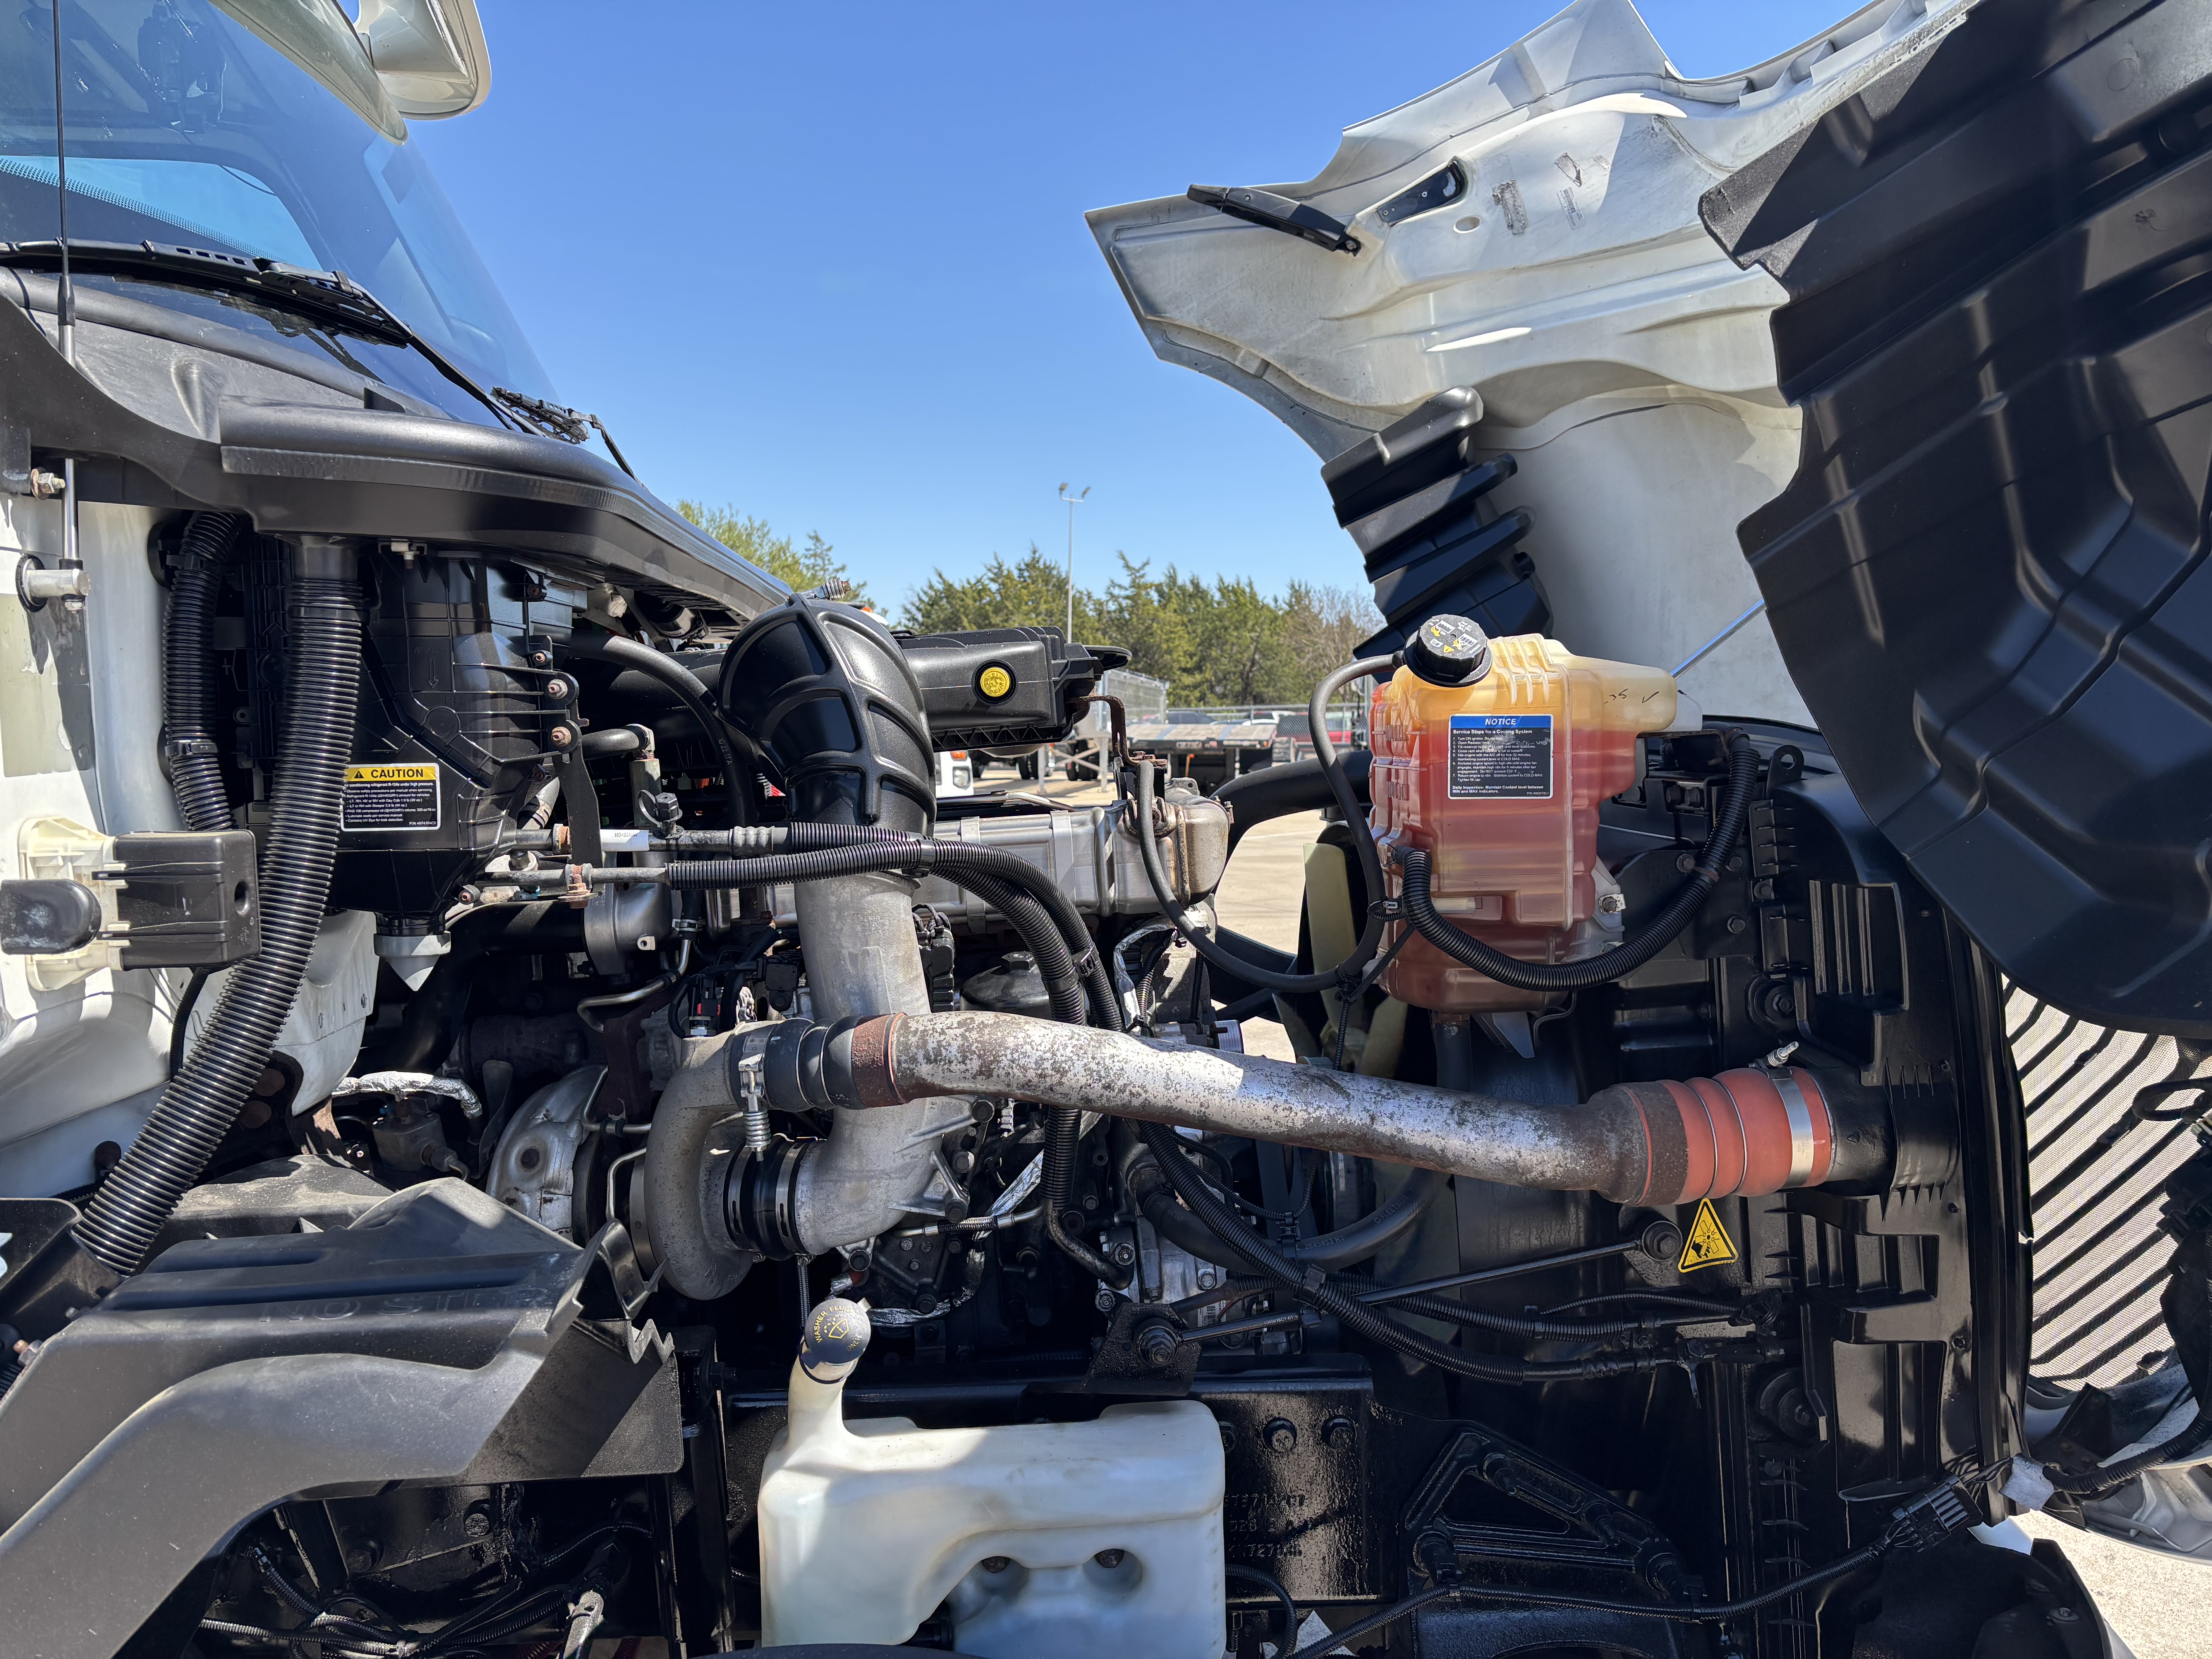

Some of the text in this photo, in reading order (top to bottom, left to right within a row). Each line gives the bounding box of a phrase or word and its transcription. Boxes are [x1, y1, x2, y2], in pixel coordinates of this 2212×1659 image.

[445, 696, 462, 706] RH
[371, 769, 423, 778] CAUTION
[258, 1298, 361, 1322] NO
[814, 1311, 828, 1343] WASHER
[847, 1333, 863, 1351] ONLY
